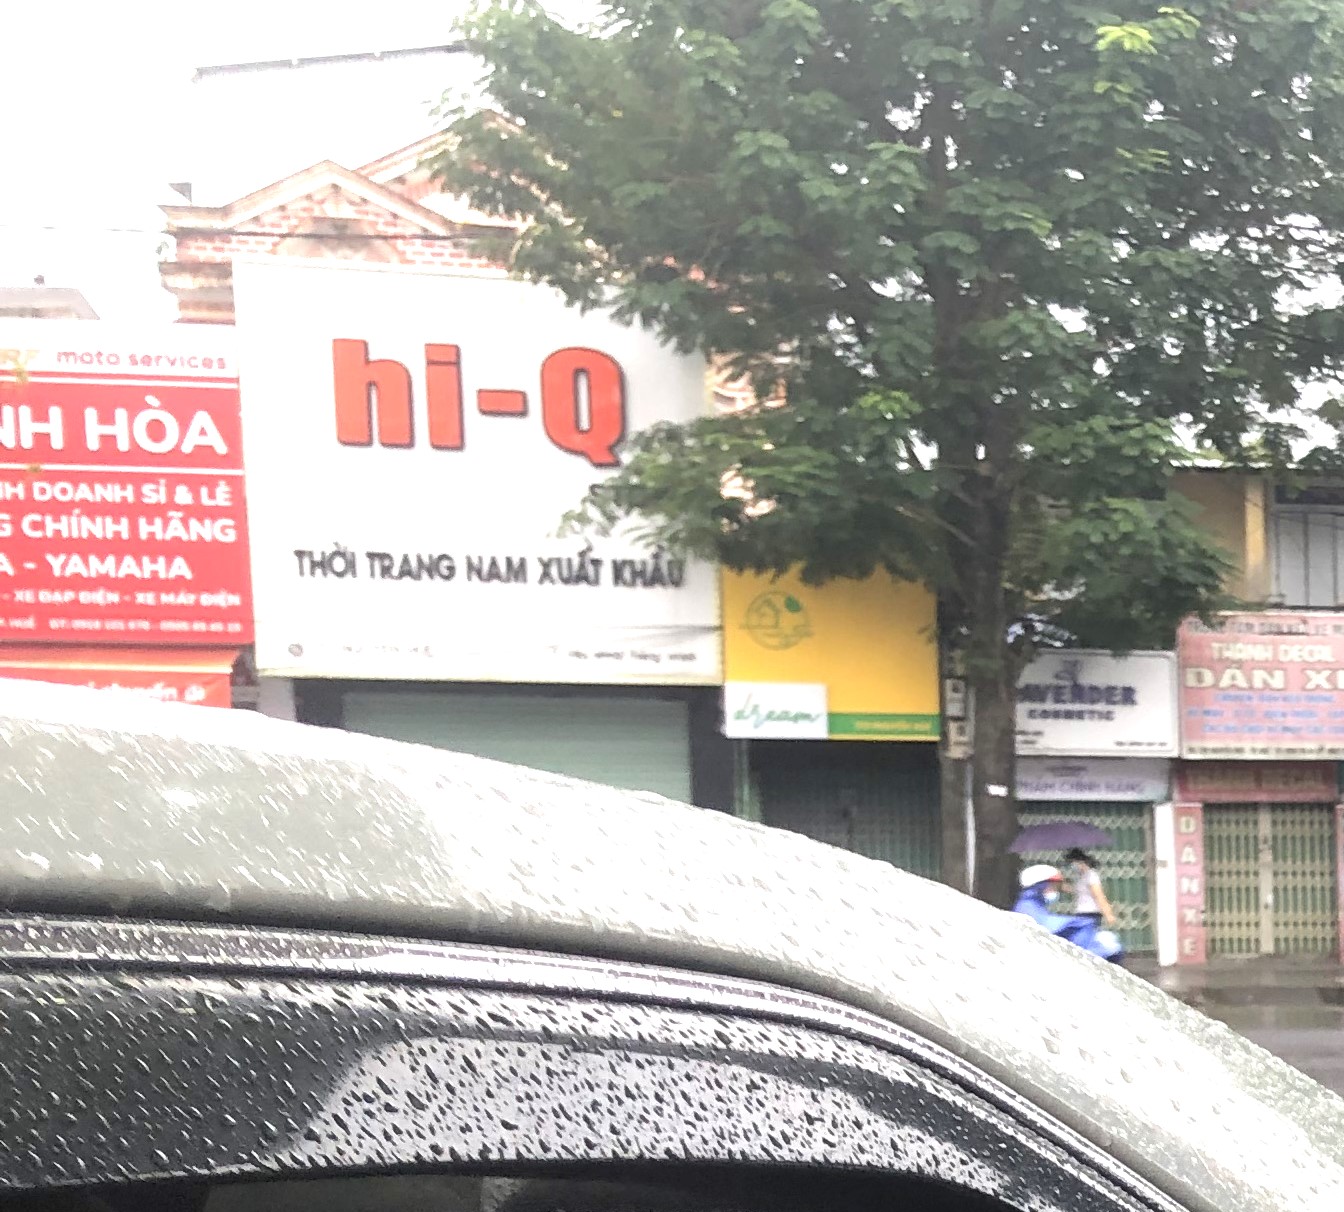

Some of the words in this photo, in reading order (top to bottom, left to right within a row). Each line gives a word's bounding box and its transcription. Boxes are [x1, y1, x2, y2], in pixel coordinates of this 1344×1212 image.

[57, 350, 121, 367] moto
[128, 352, 227, 370] services
[332, 338, 625, 466] hi-Q
[84, 394, 229, 455] HÒA
[32, 481, 135, 504] DOANH
[21, 508, 130, 540] CHÍNH
[138, 510, 237, 543] HÃNG
[45, 551, 193, 580] YAMAHA
[293, 541, 357, 579] THỜI
[365, 550, 457, 581] TRANG
[465, 554, 528, 584] NAM
[537, 537, 603, 588] XUẤT
